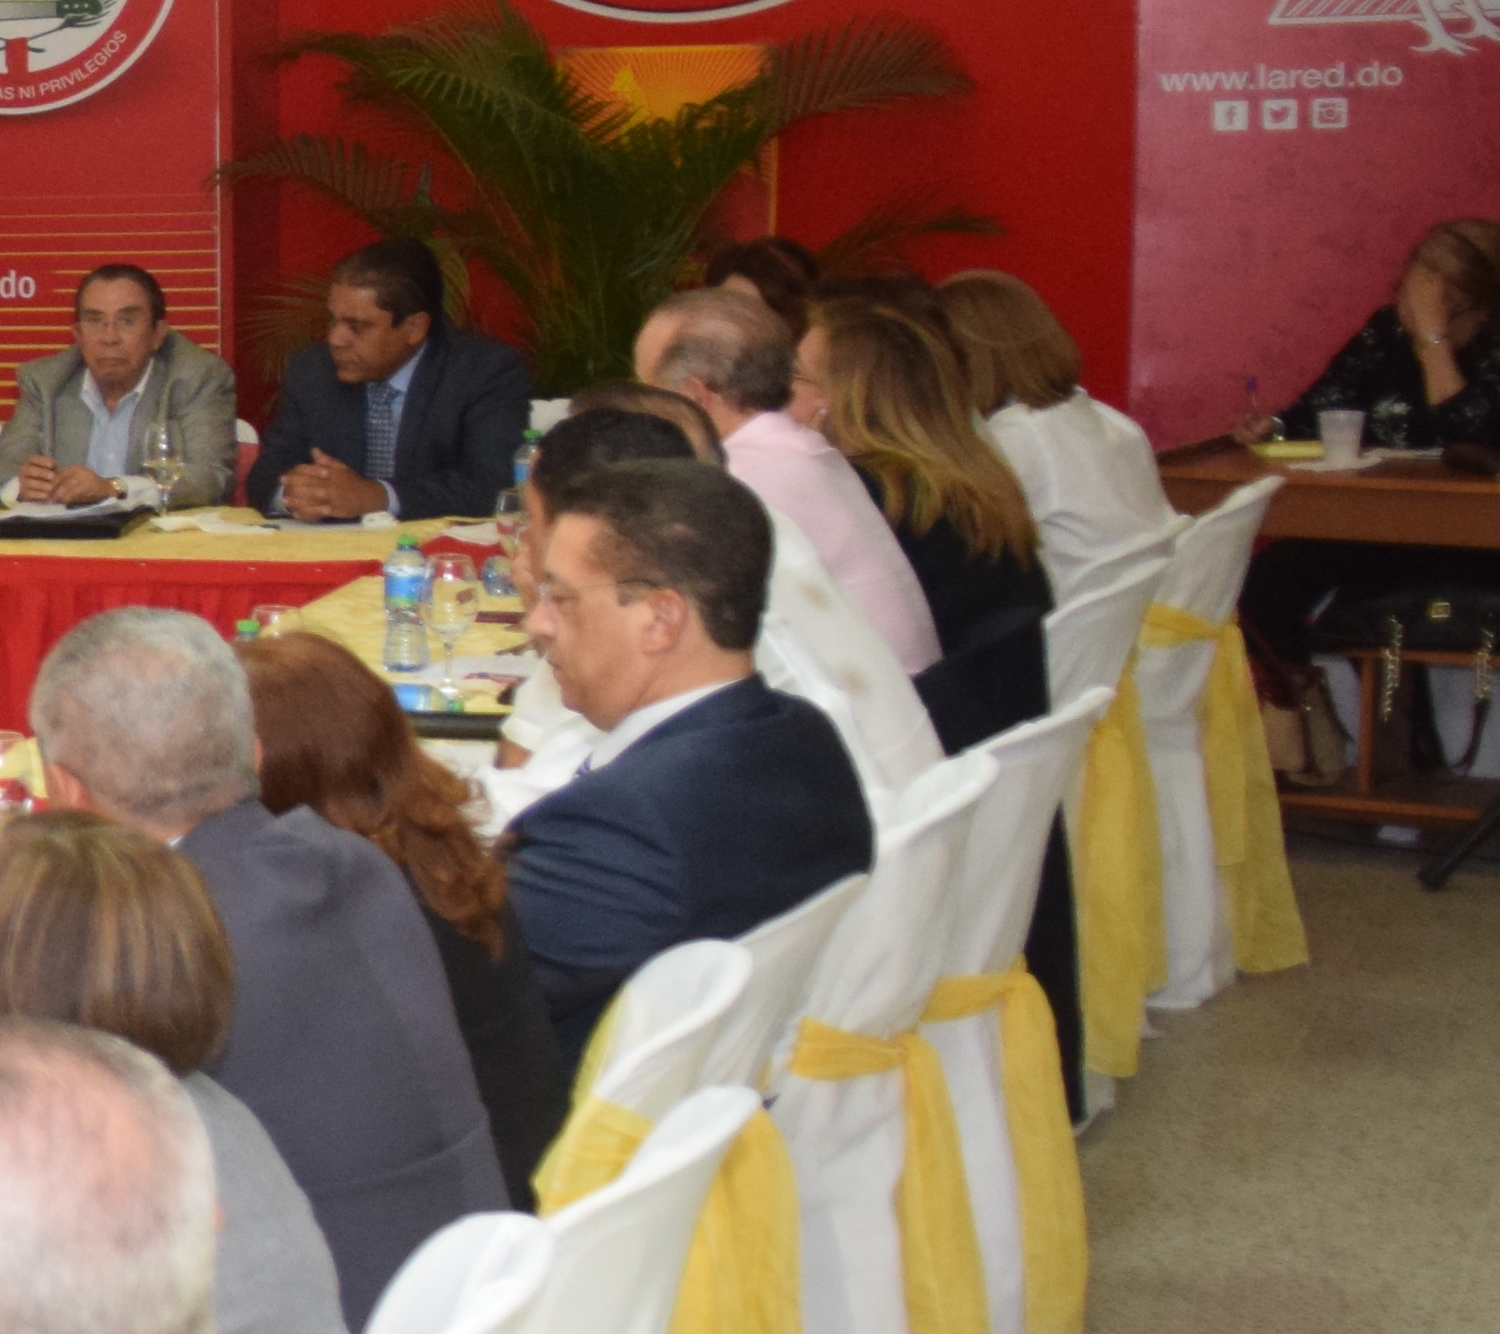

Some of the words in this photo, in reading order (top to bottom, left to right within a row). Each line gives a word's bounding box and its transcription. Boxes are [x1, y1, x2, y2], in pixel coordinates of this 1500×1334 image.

[19, 85, 36, 99] NI
[39, 30, 128, 95] PRIVILEGIOS
[1159, 60, 1404, 92] www.lared.do
